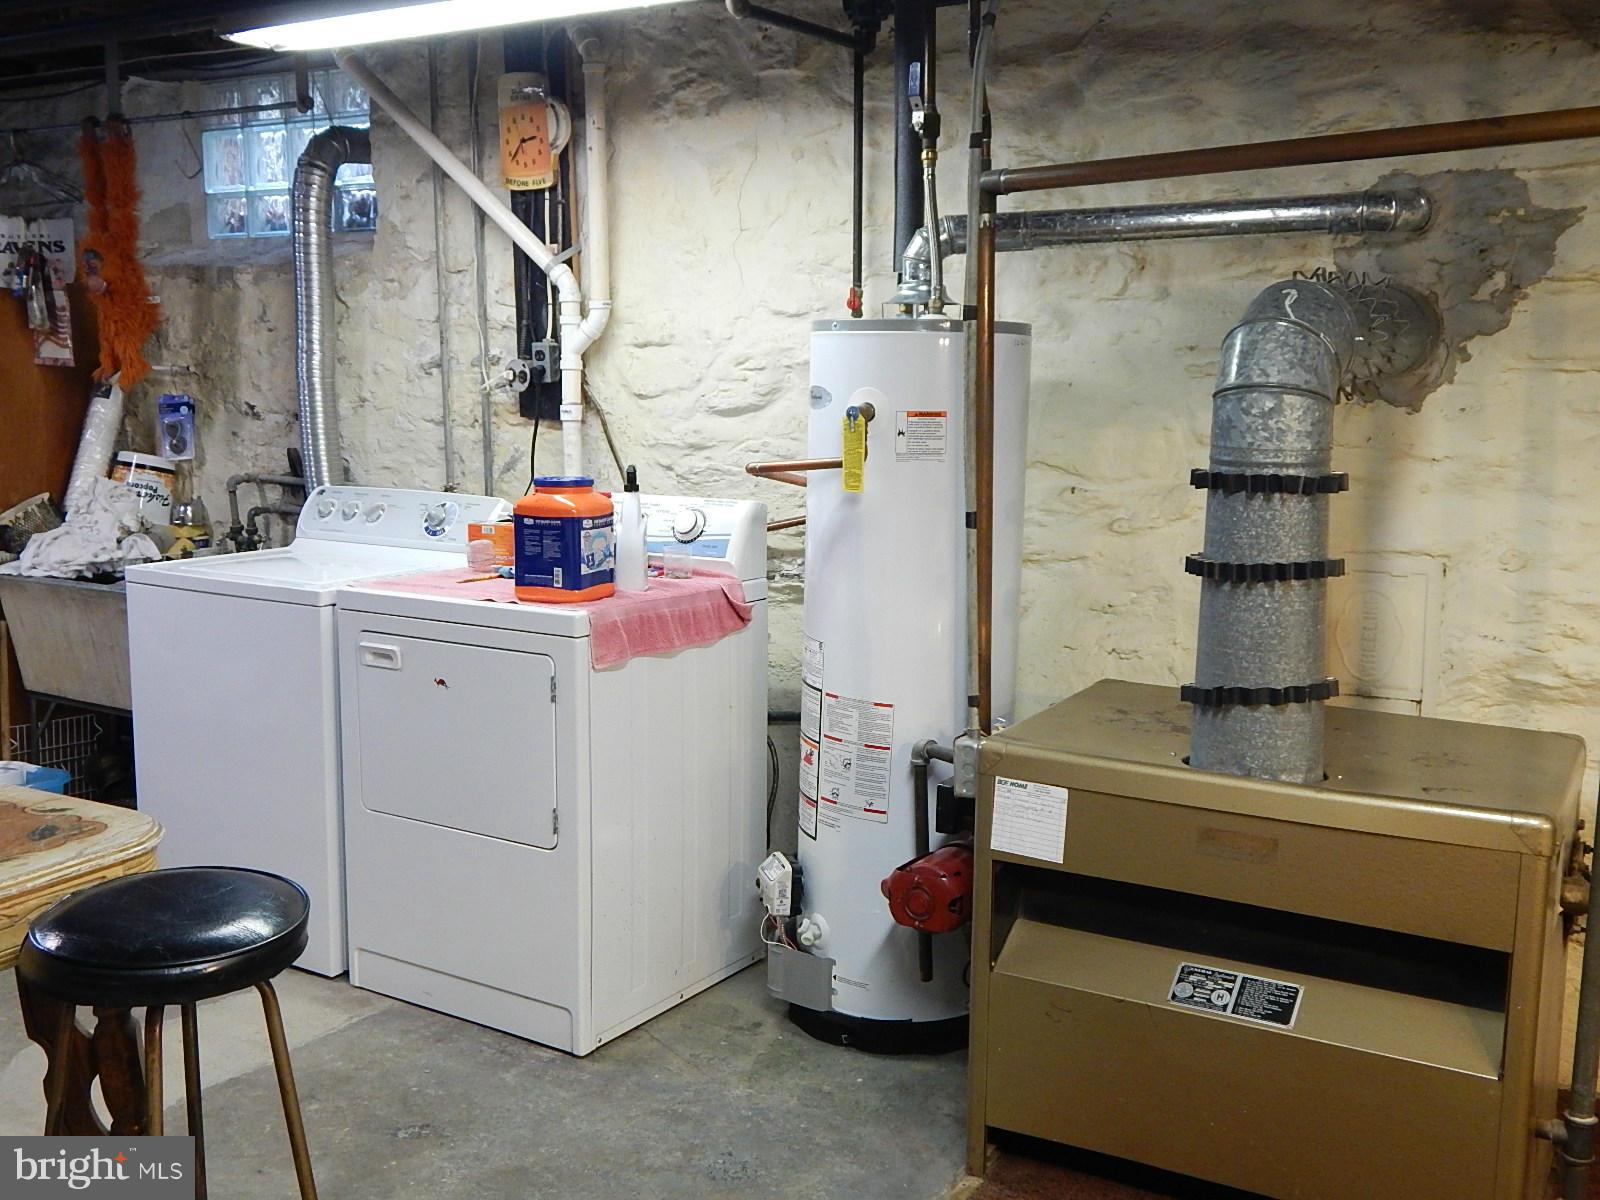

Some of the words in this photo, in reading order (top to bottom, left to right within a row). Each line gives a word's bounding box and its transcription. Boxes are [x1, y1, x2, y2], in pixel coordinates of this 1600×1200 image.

[505, 177, 529, 187] BEFORE
[126, 481, 158, 494] Popcorn
[1009, 781, 1028, 790] HOME
